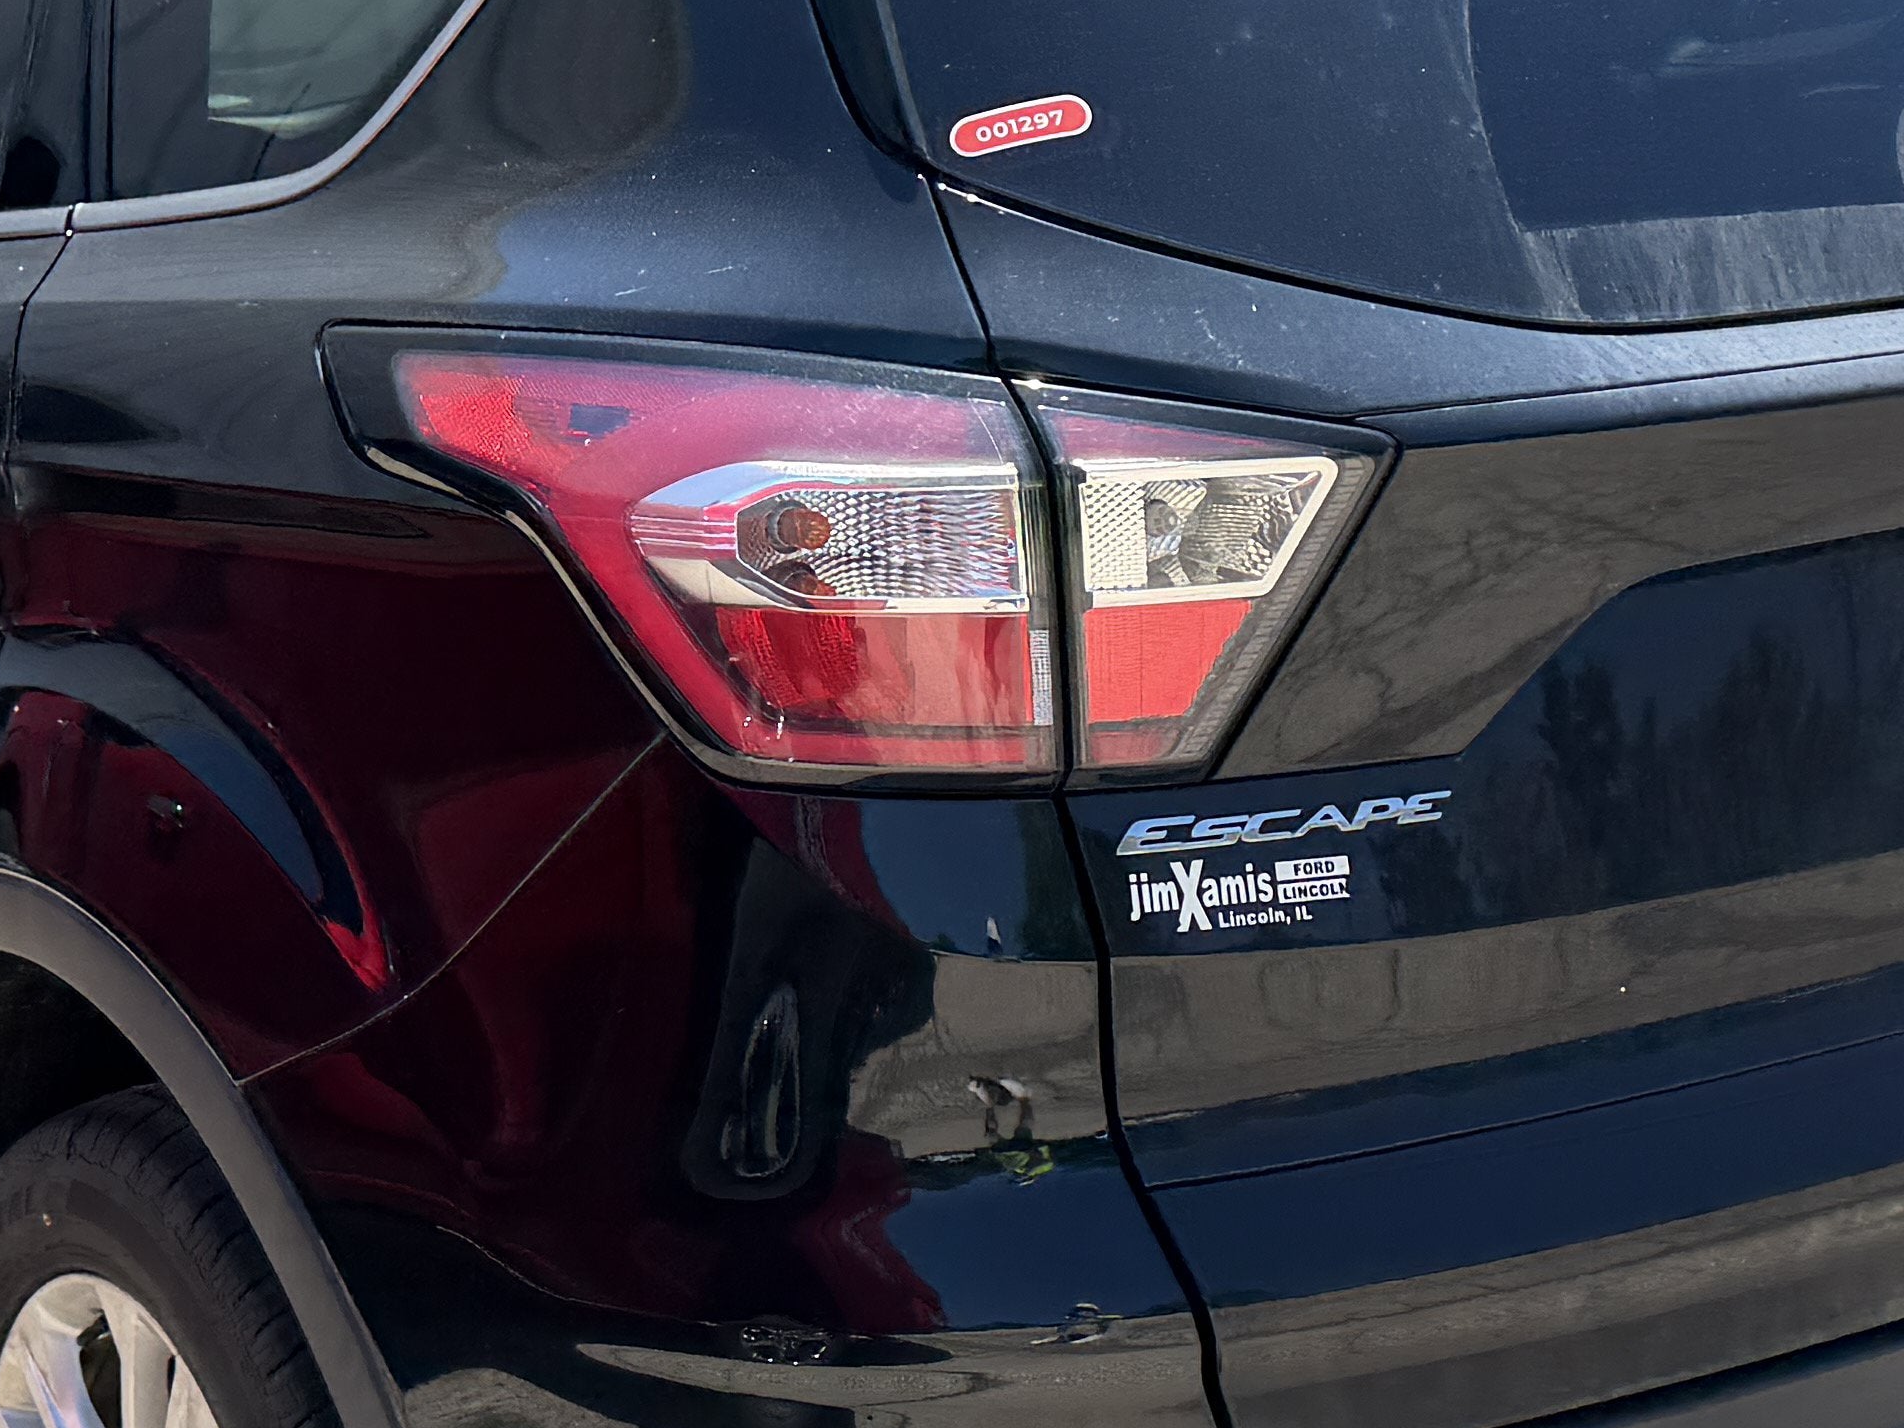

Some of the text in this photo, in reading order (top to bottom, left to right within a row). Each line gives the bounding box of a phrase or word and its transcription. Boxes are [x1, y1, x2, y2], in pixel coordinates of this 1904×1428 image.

[975, 108, 1064, 143] 001297
[1115, 790, 1452, 856] ESCAPE
[1292, 860, 1335, 876] FORD
[1283, 881, 1348, 900] LINCOLN
[1218, 904, 1313, 929] Lincoln, IL
